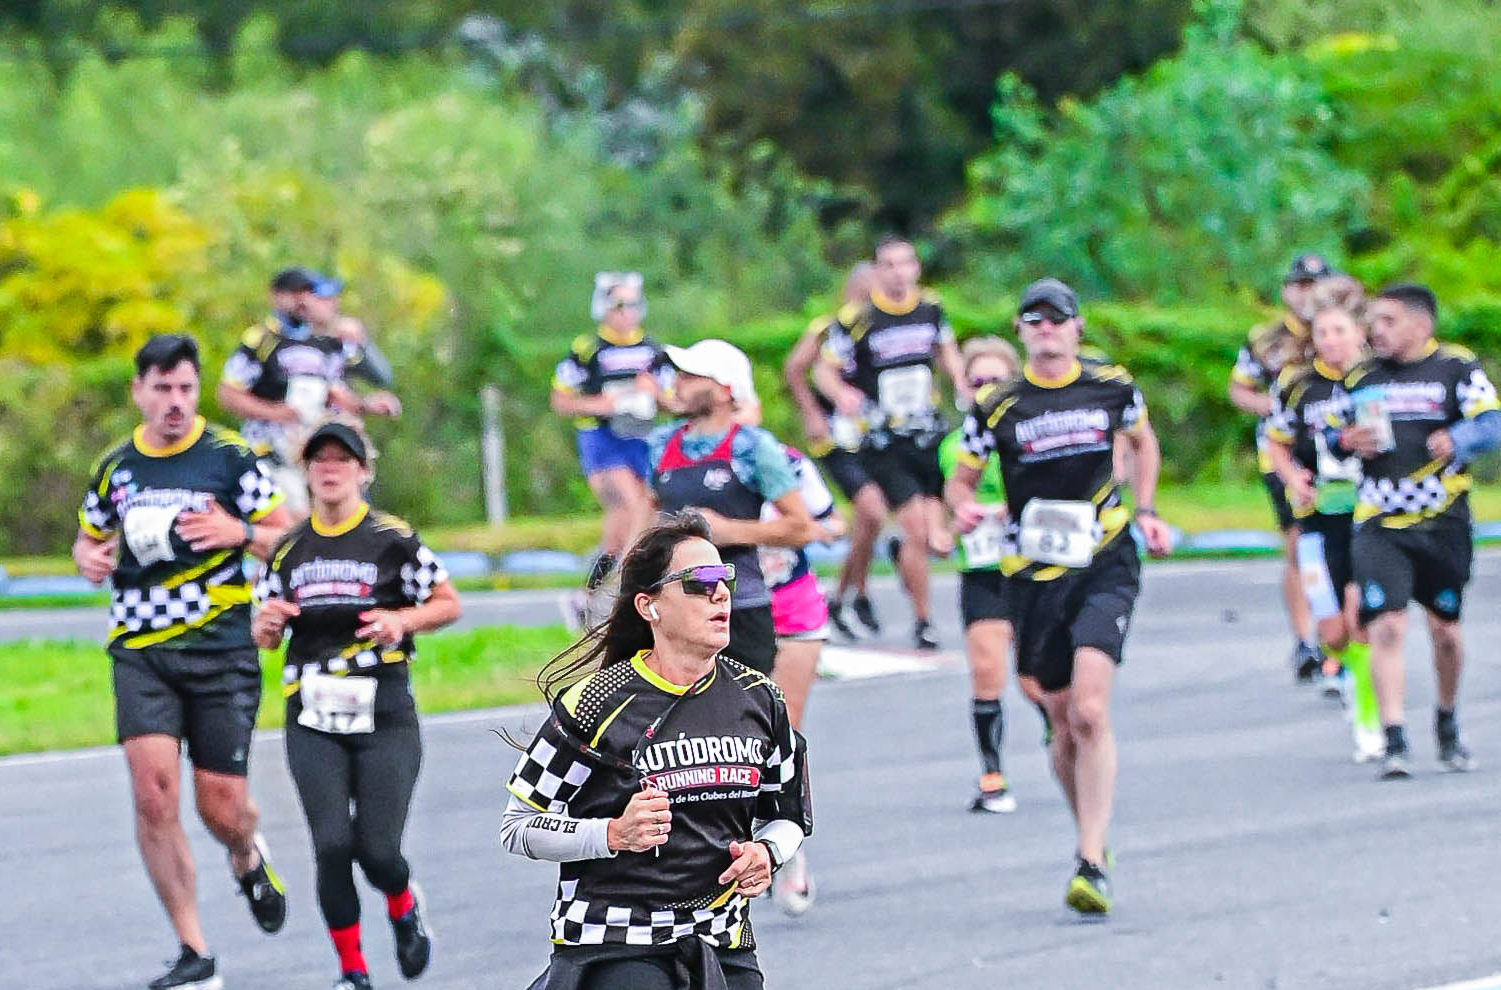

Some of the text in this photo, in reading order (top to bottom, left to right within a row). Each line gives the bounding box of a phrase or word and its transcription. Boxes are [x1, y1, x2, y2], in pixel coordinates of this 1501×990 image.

[656, 768, 752, 791] RUNNING RACE
[675, 795, 687, 804] de
[687, 793, 700, 802] los
[700, 791, 727, 801] Clubes
[728, 789, 741, 799] del
